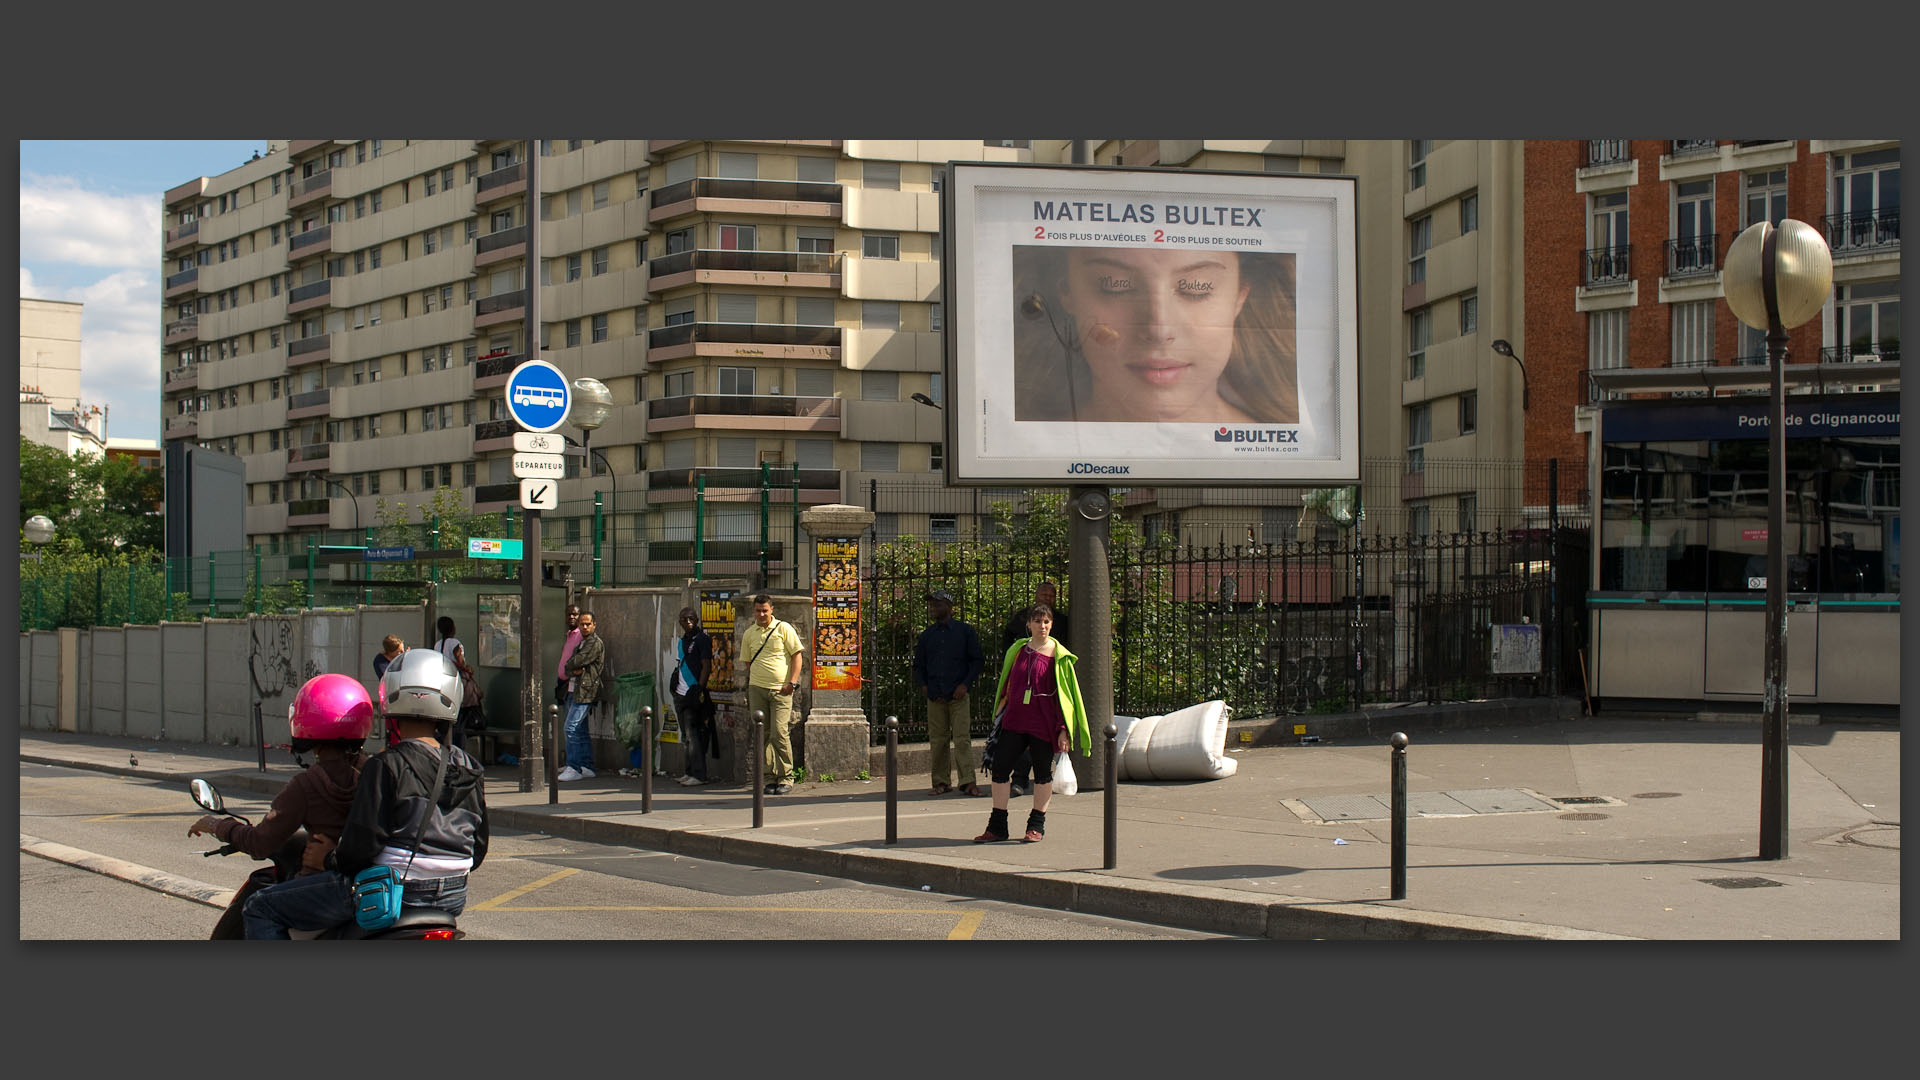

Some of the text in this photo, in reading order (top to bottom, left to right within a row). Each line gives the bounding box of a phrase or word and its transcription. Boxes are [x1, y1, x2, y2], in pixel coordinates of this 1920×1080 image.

[1034, 201, 1262, 227] MATELAS BULTEX
[1034, 226, 1262, 246] 2 FOIS PLUS D'ALVÉOLES 2 FOIS PLUS DE SOUTIEN
[1099, 276, 1214, 291] Merci Bultex
[1785, 414, 1803, 425] de
[1810, 413, 1900, 428] Clignancour
[1234, 430, 1298, 443] BULTEX
[515, 461, 562, 470] SÉPARATEUR
[1067, 463, 1130, 474] JCDecaux
